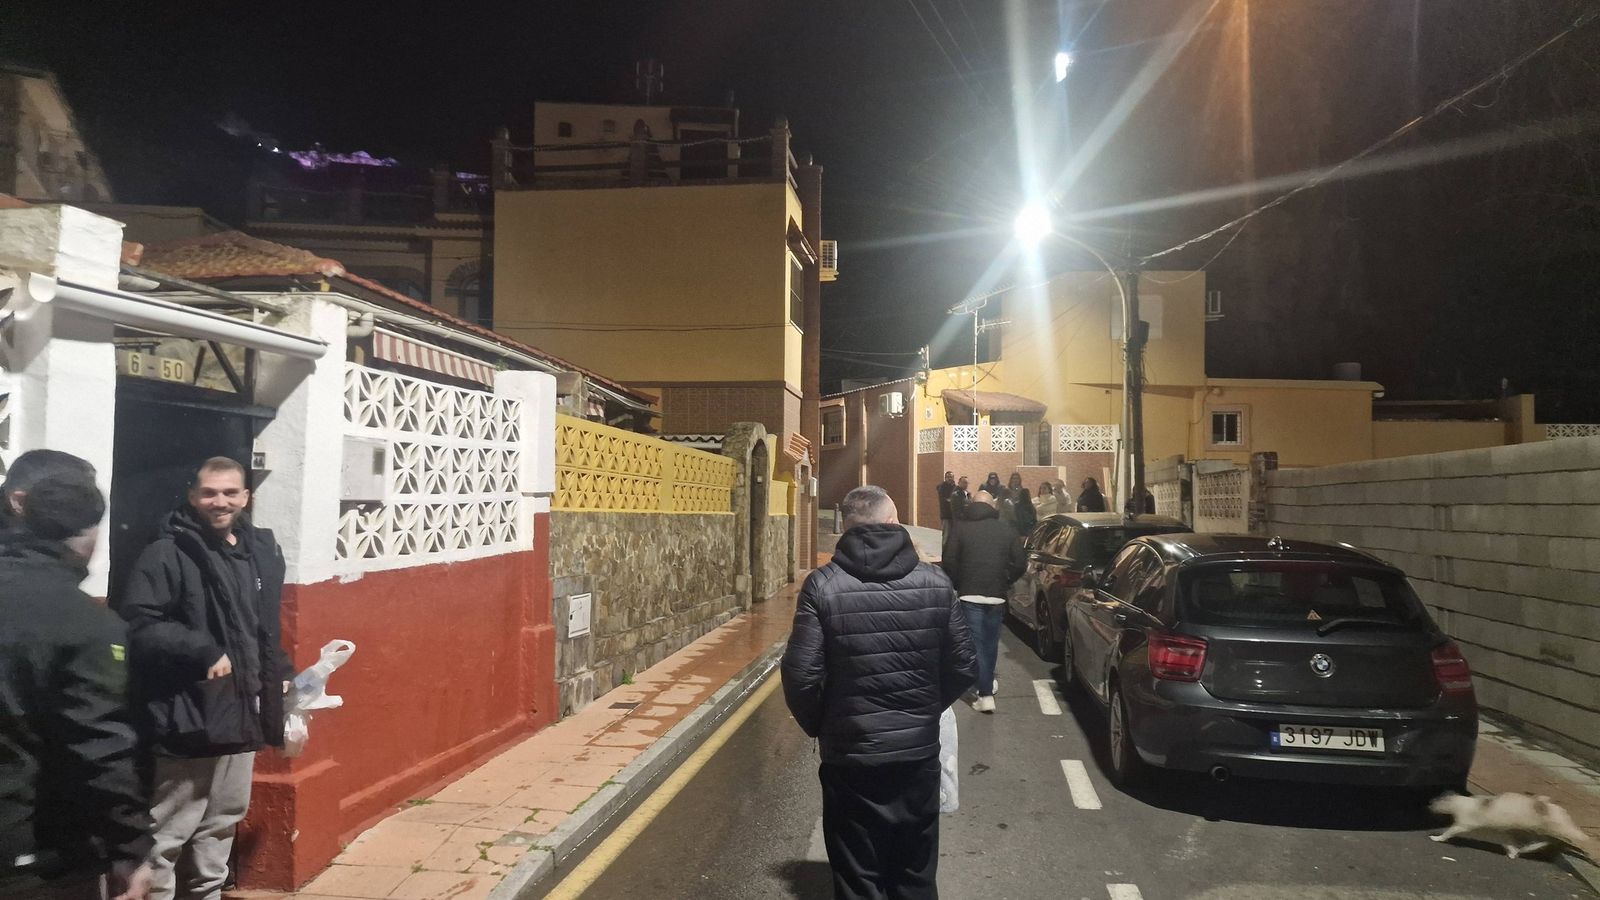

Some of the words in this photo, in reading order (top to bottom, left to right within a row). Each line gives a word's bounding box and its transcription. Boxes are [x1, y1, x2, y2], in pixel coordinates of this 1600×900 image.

[131, 354, 140, 374] 6
[163, 360, 183, 380] 50
[1285, 726, 1334, 746] 3197
[1343, 729, 1378, 748] JDW
